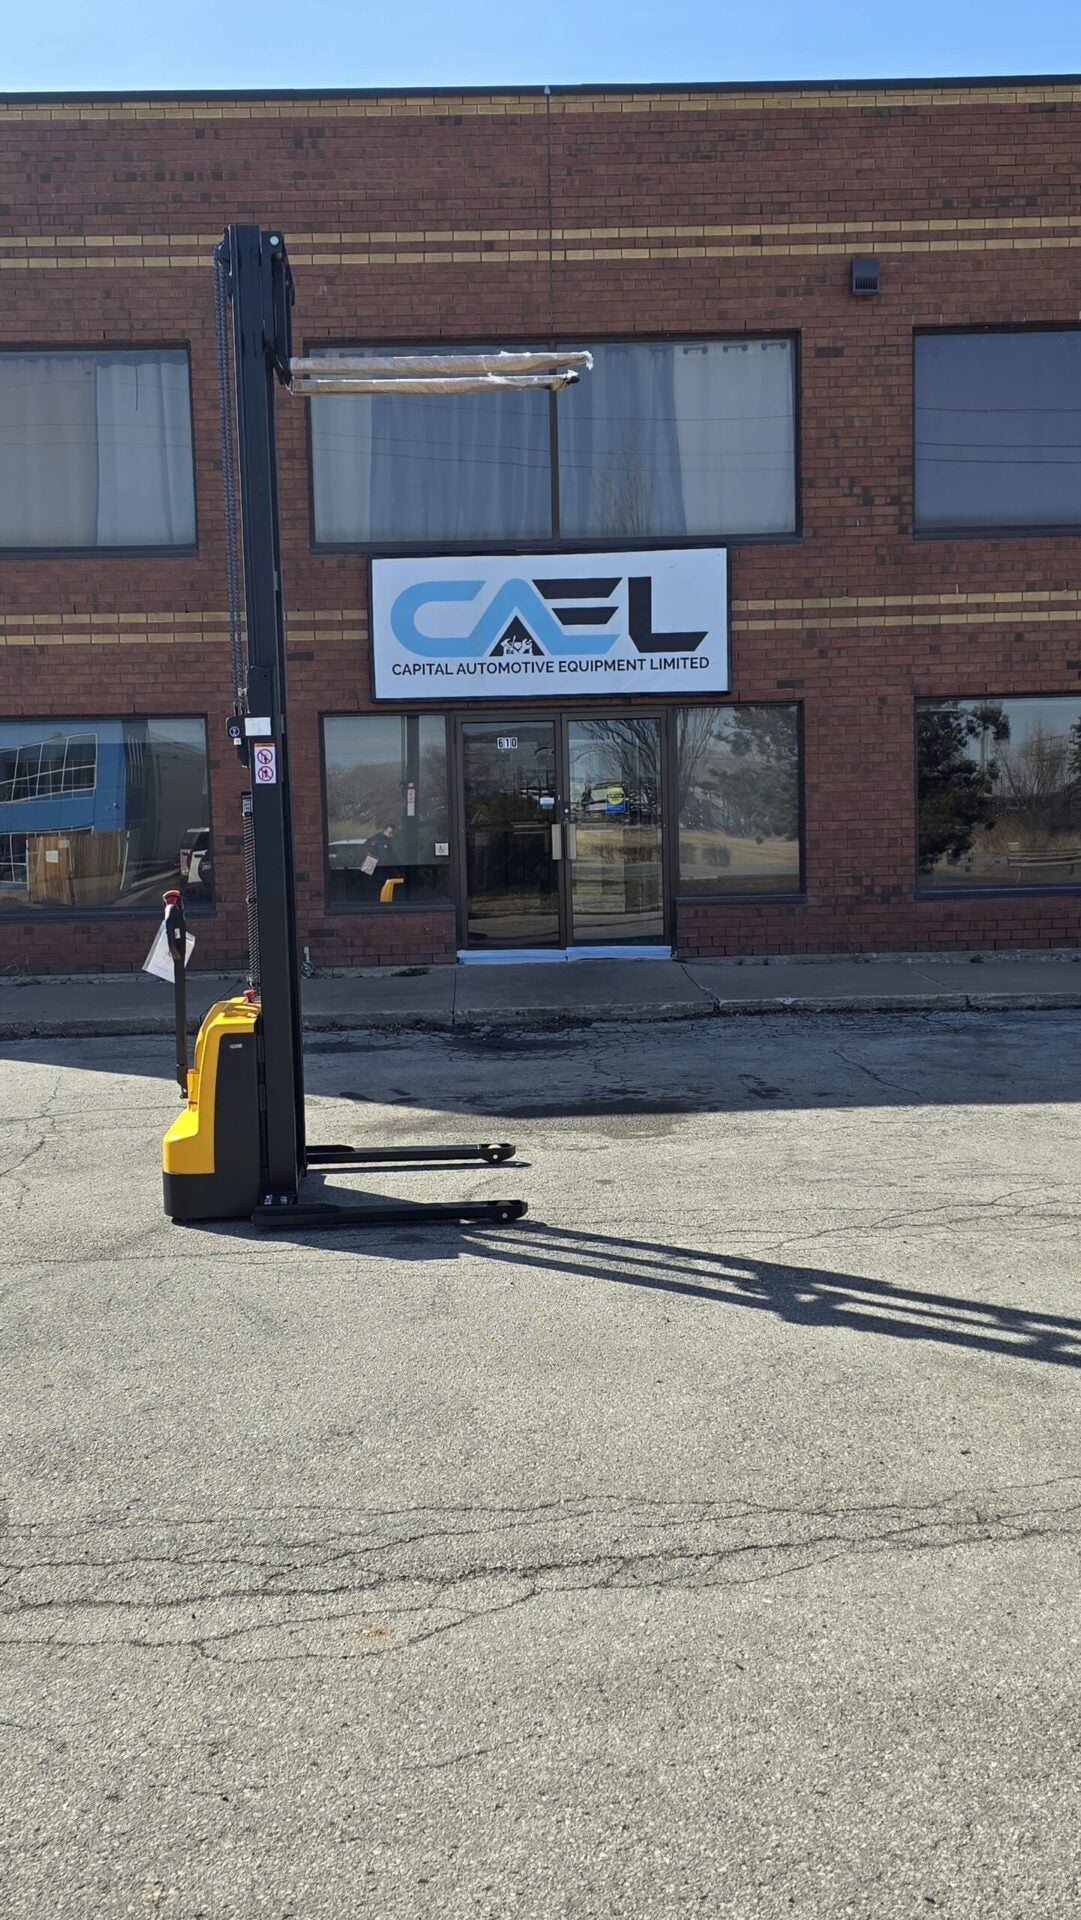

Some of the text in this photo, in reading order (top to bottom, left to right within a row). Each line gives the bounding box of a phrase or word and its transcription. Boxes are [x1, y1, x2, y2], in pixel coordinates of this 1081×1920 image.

[390, 576, 708, 657] CAEL
[392, 657, 709, 676] CAPITAL AUTOMOTIVE EQUIPMENT LIMITED
[497, 737, 518, 749] 610
